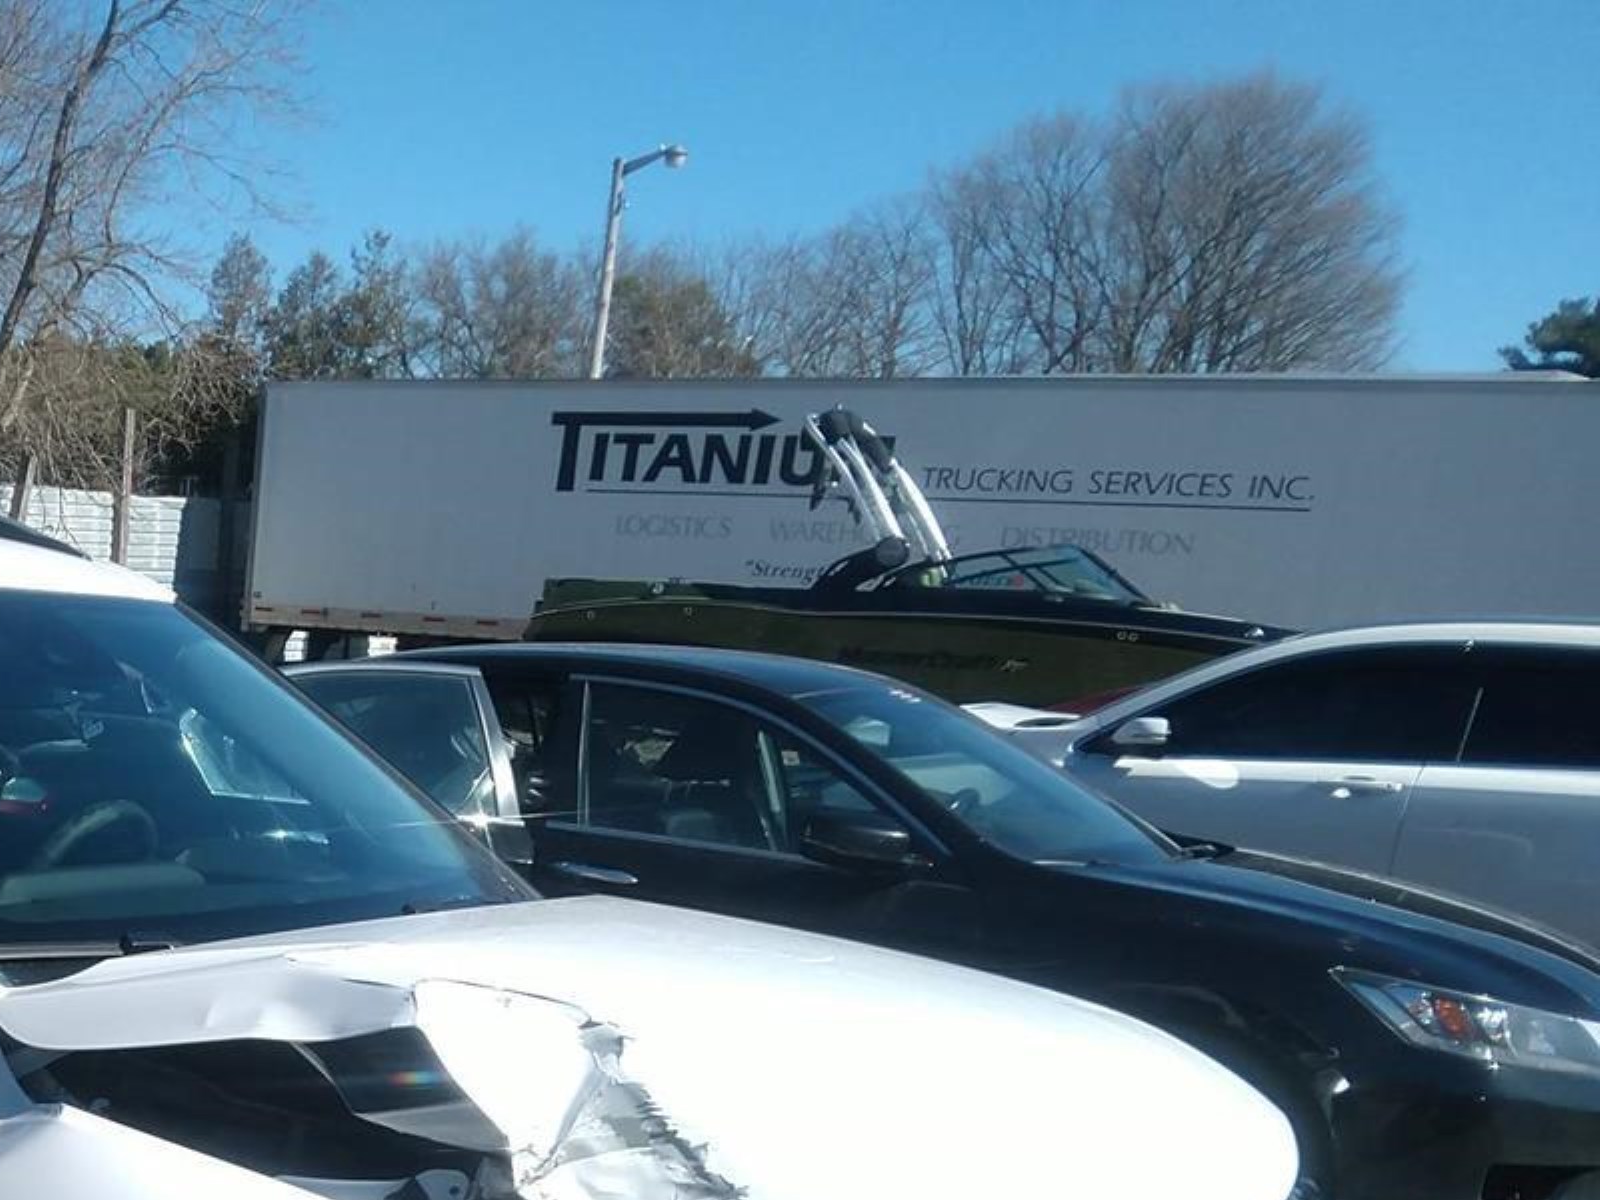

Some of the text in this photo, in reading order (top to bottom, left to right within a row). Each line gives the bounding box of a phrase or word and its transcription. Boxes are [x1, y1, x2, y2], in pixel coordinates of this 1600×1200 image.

[551, 408, 1316, 500] TITANIU TRUCKING SERVICES INC.
[616, 514, 733, 539] LOGISTICS
[1001, 526, 1195, 555] DISTRIBUTION
